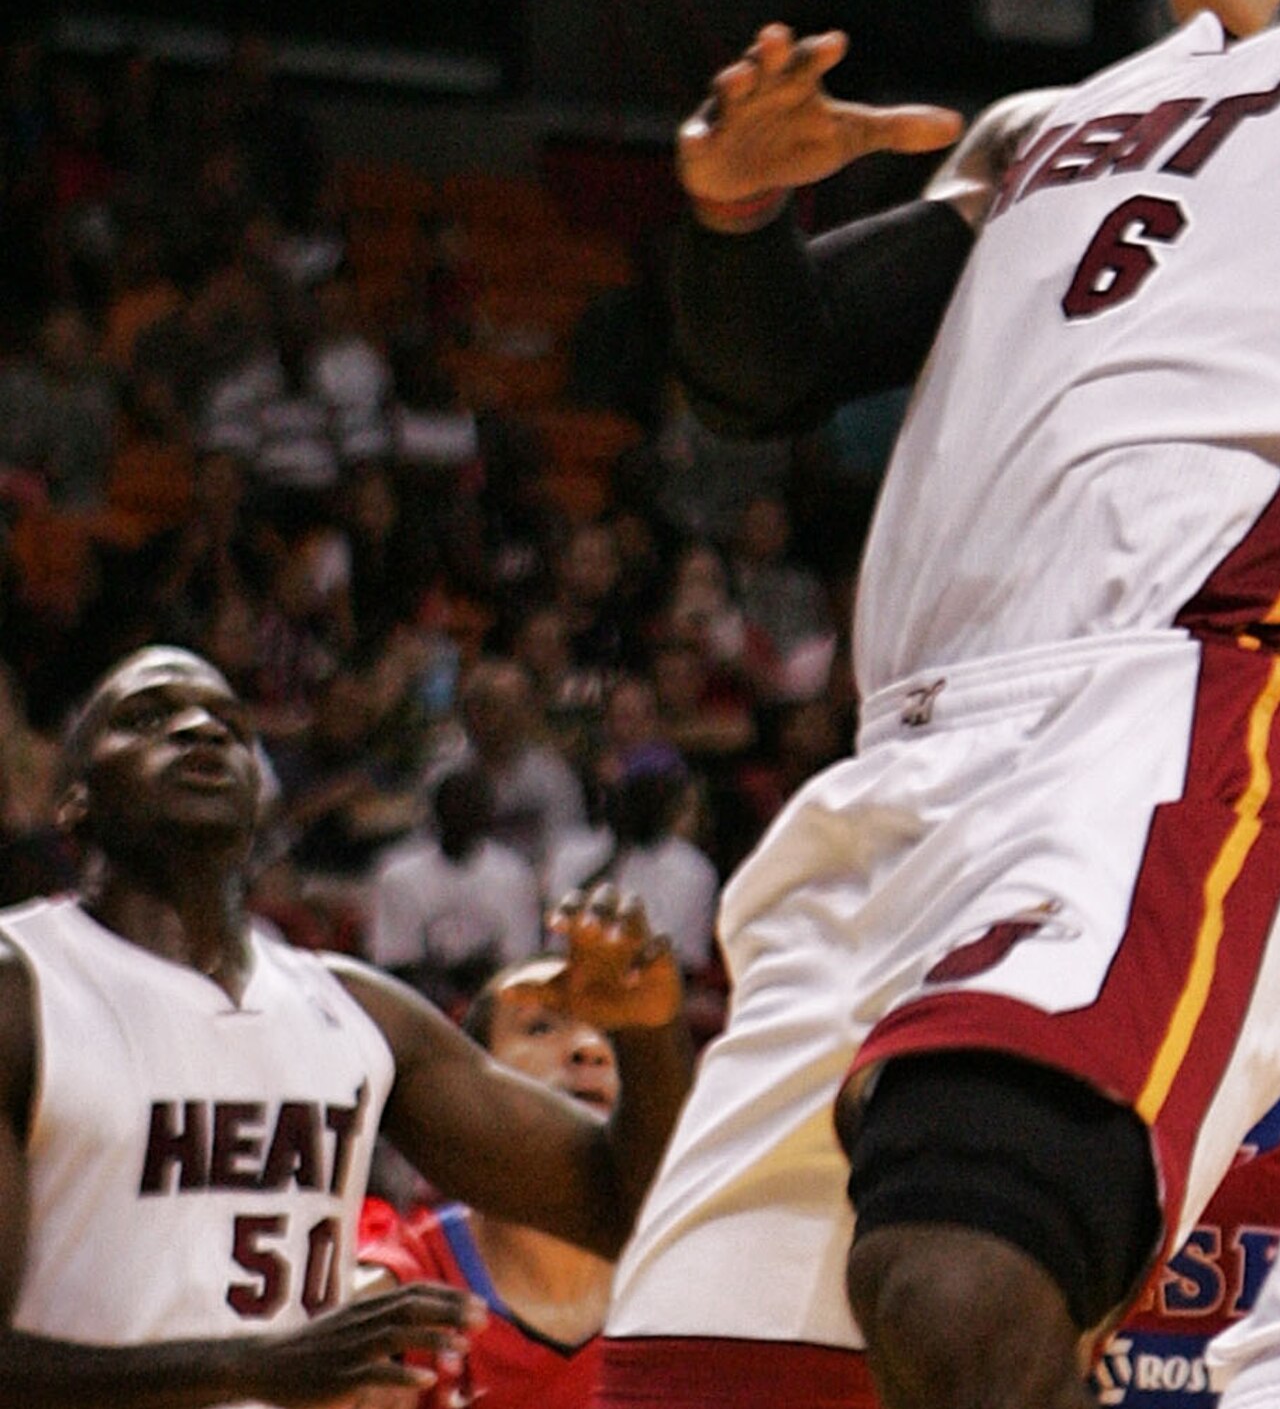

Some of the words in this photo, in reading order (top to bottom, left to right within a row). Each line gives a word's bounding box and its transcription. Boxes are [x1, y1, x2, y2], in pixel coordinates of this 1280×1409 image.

[1061, 193, 1189, 321] 6
[138, 1074, 369, 1199] HEAT
[225, 1212, 342, 1321] 50
